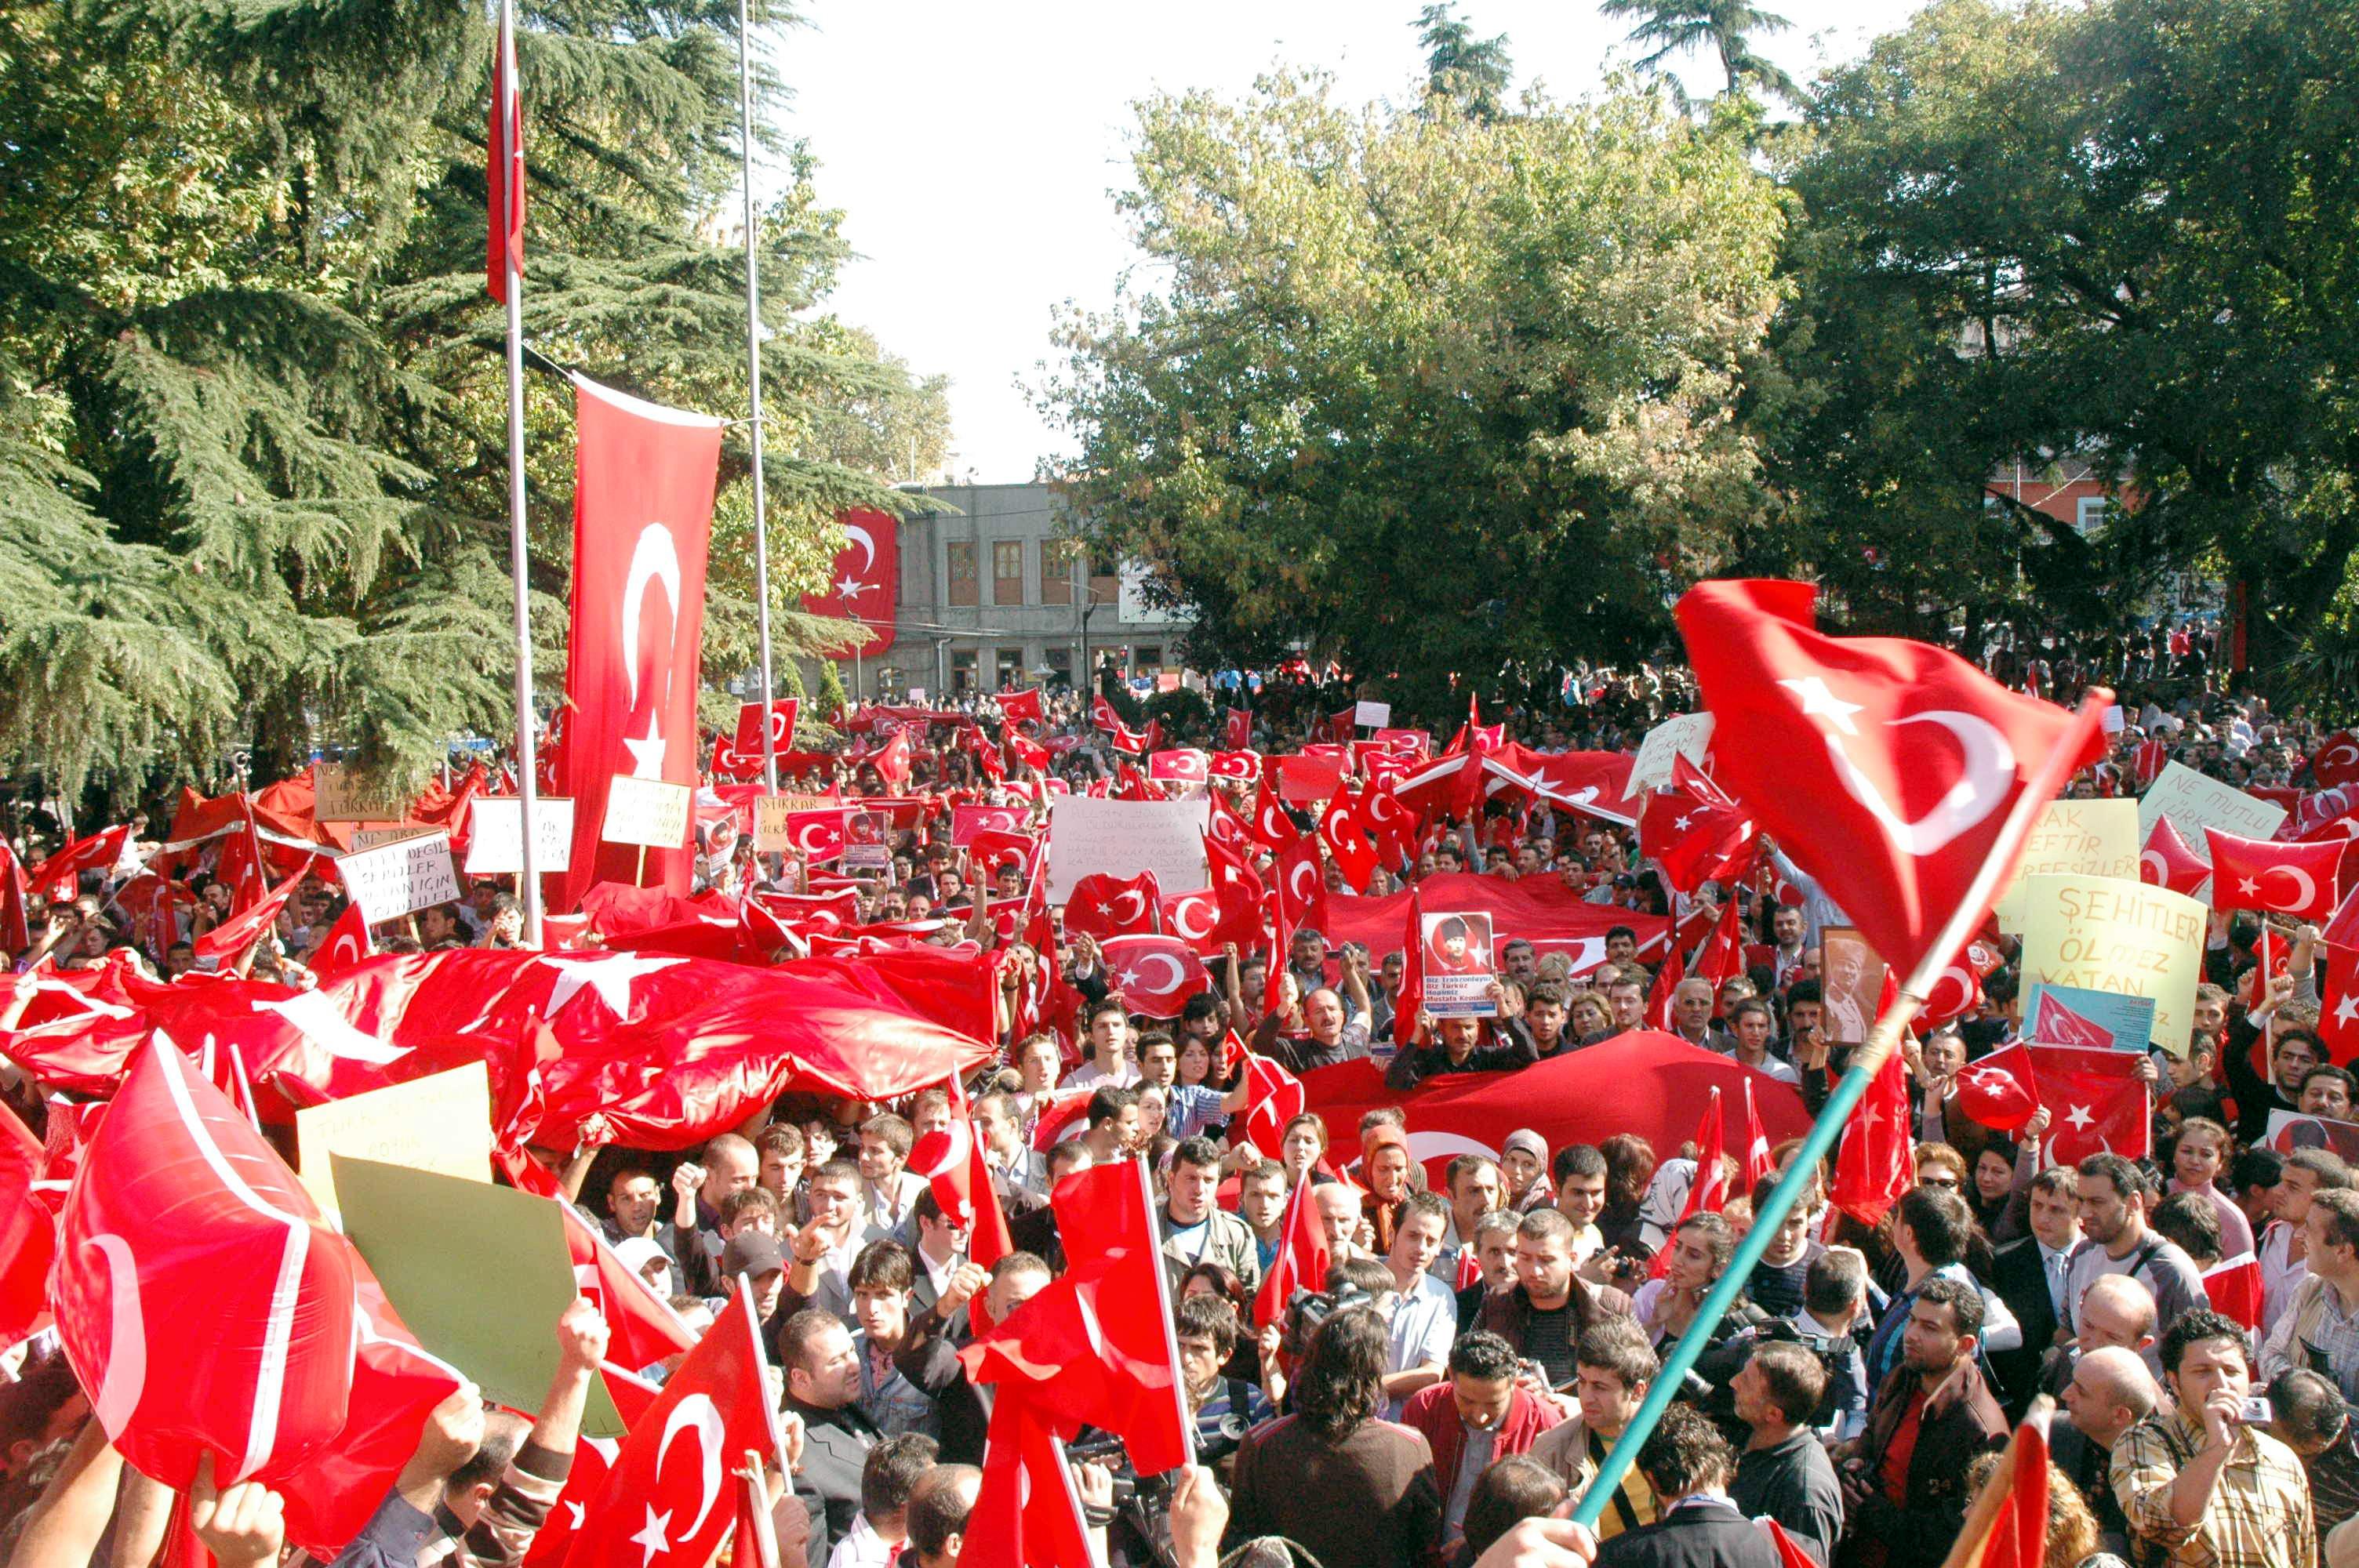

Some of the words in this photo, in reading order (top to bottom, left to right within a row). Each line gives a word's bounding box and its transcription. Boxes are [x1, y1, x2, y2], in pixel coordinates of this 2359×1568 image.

[2168, 773, 2203, 796] NE
[2205, 790, 2272, 830] MUTLU
[2037, 808, 2084, 829] AK
[2026, 830, 2103, 856] EFTİR
[2012, 854, 2139, 880] REFSİZLER
[2057, 886, 2200, 951] ŞEHİTLER
[2059, 927, 2171, 974] ÖLMEZ
[2038, 966, 2145, 996] VATAN
